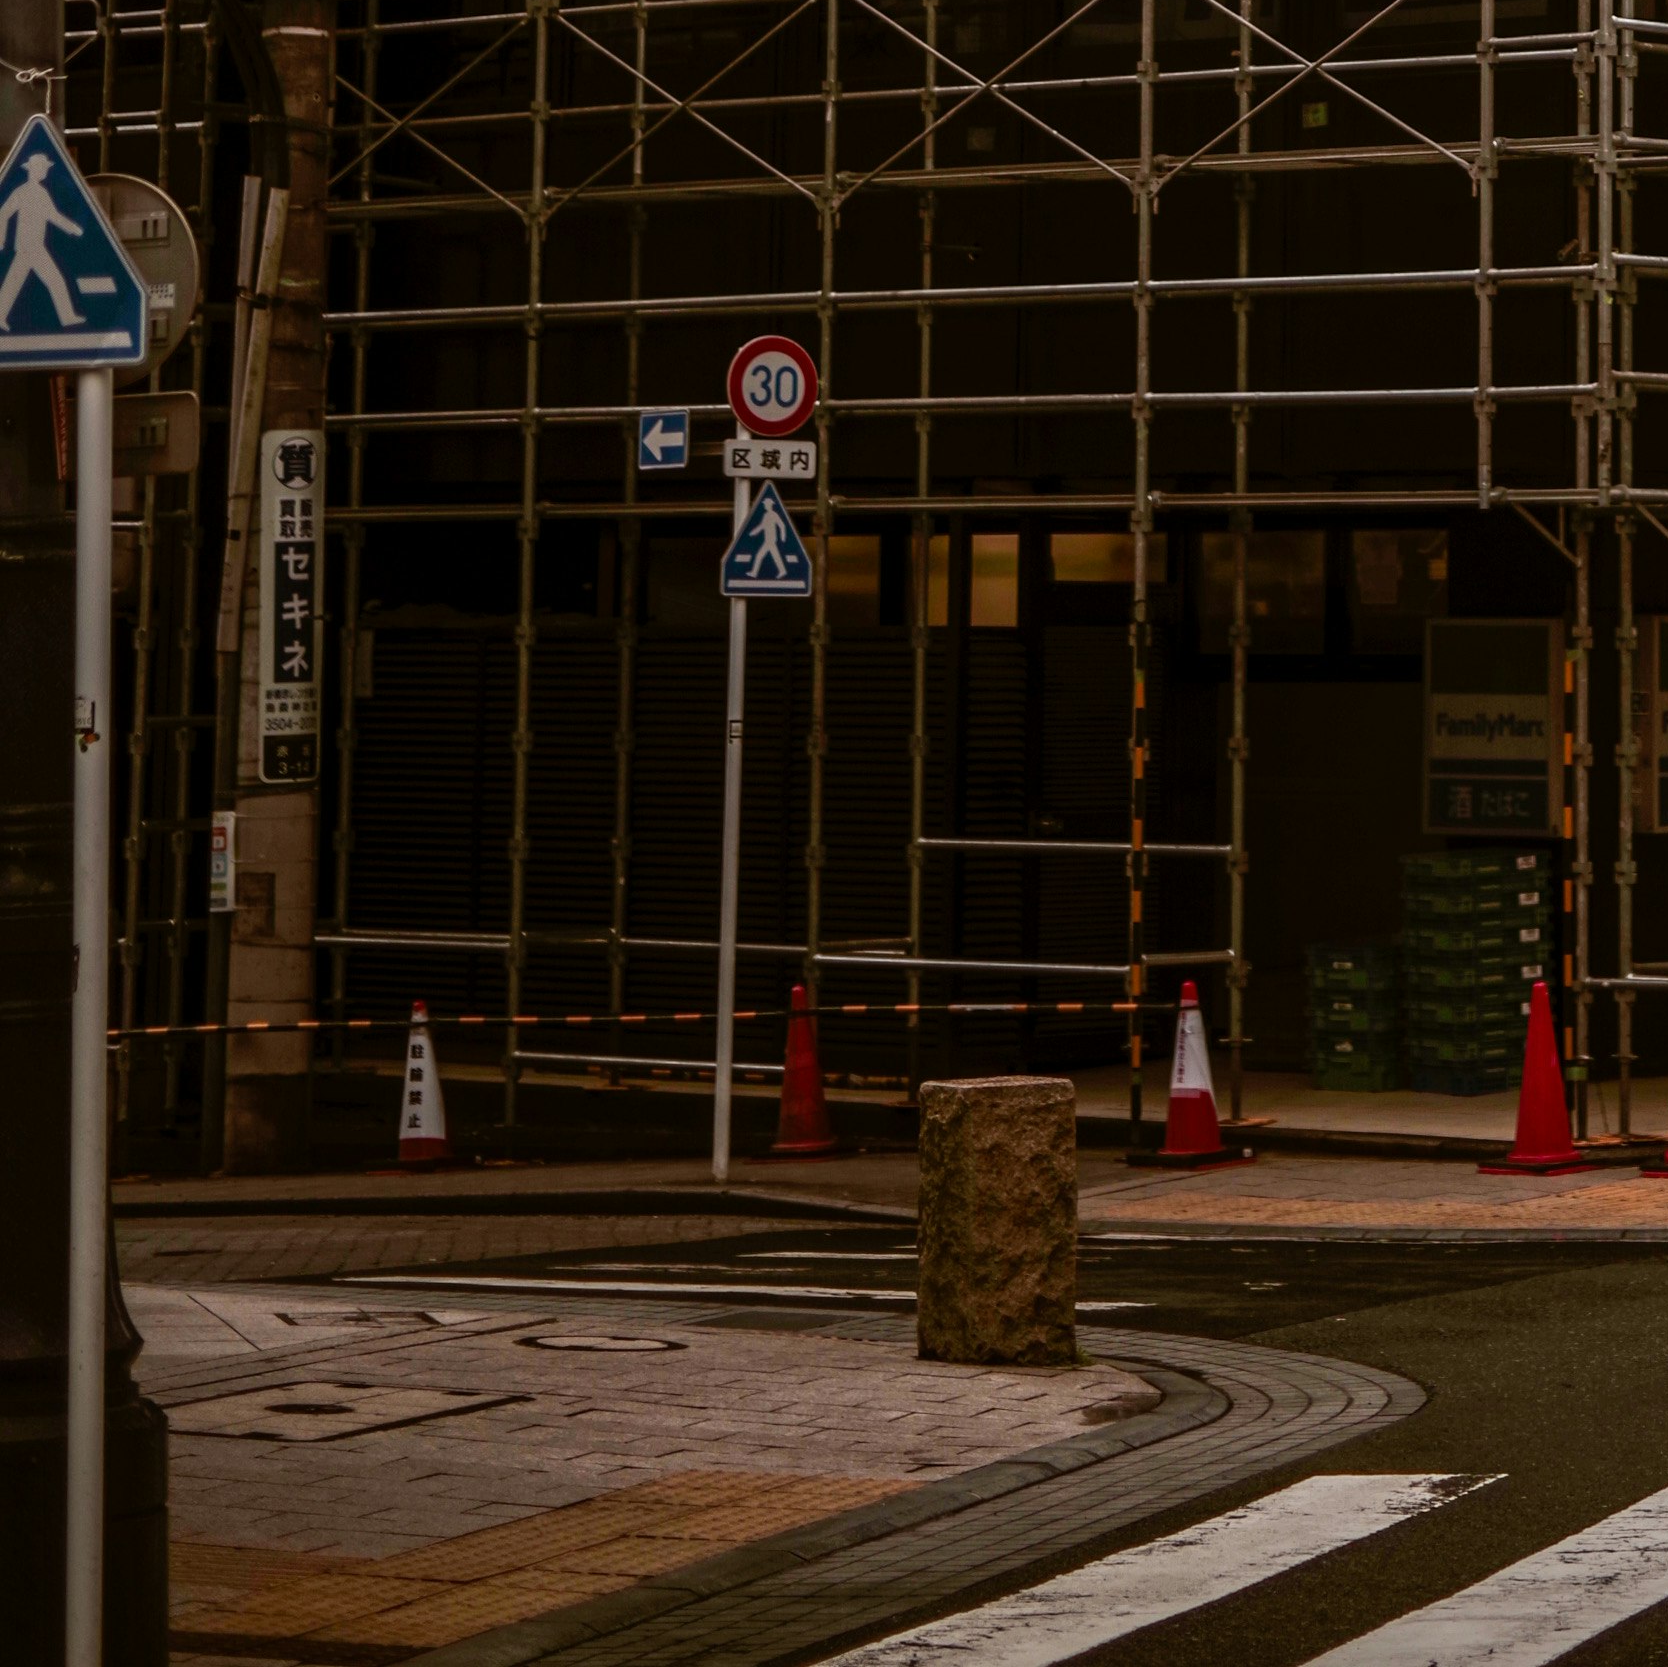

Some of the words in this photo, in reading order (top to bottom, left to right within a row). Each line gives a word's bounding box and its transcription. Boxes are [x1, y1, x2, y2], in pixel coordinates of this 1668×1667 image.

[750, 364, 799, 408] 30
[278, 442, 316, 484] 質
[732, 448, 810, 471] 区域内
[279, 545, 310, 680] セキネ
